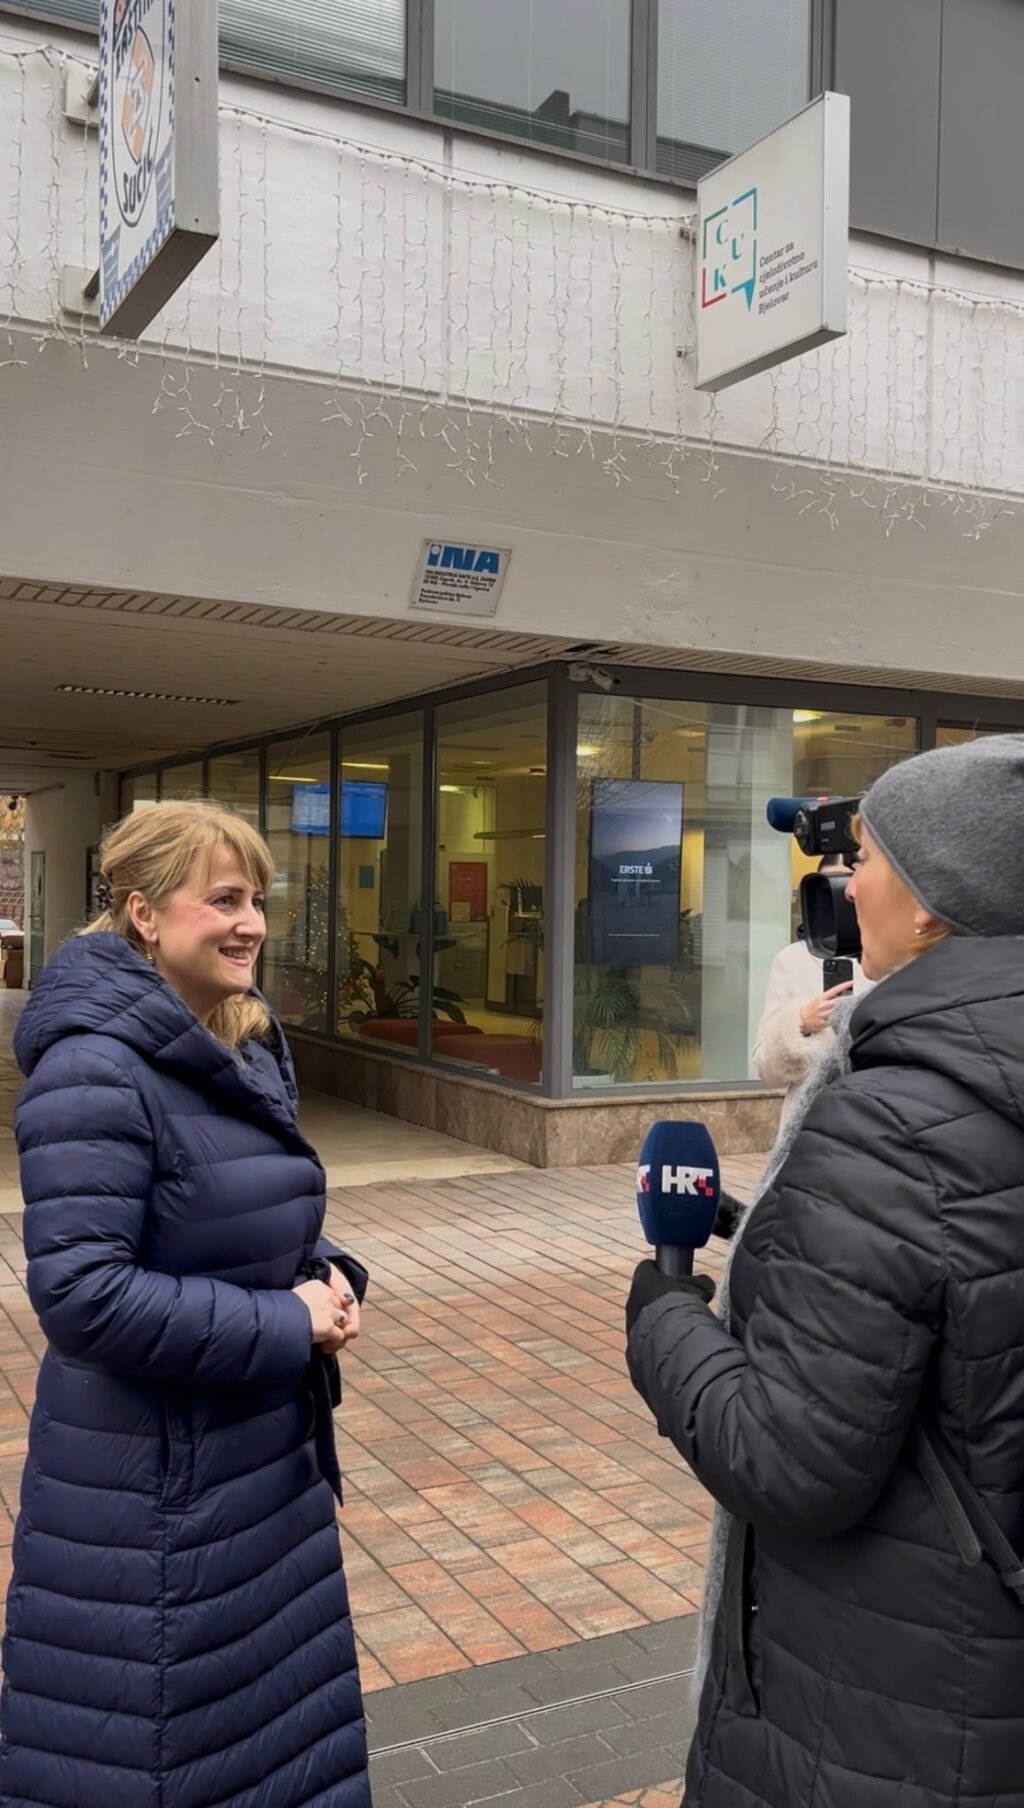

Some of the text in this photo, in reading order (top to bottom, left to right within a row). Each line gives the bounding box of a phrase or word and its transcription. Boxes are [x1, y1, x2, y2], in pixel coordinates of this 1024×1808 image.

[759, 241, 795, 268] Centar za
[789, 260, 818, 283] kulturu
[758, 291, 789, 315] Bjelovar
[427, 543, 499, 574] INA
[619, 865, 644, 874] ERSTE
[661, 1165, 713, 1196] HRT
